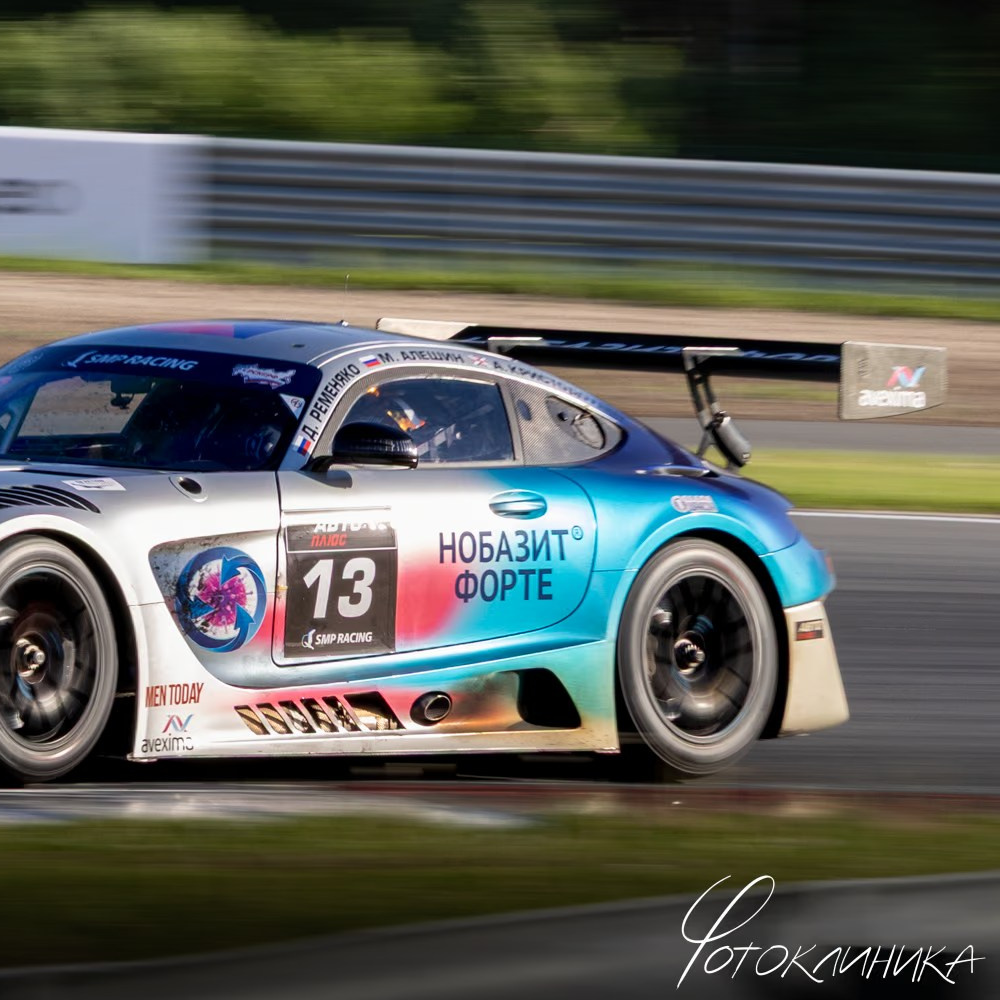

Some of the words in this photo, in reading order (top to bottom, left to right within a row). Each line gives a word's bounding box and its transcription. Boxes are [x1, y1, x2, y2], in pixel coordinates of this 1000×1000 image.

[86, 354, 129, 364] SMP
[124, 355, 199, 371] RACING
[377, 352, 400, 364] М.
[401, 350, 466, 364] АЛЕШИН
[309, 363, 361, 424] РЕМЕНЯКО
[302, 421, 319, 442] Д.
[311, 533, 348, 547] ПЛЮС
[303, 557, 377, 619] 13
[455, 568, 553, 603] ФОРТЕ
[315, 633, 337, 645] SMP
[337, 632, 373, 645] RACING
[145, 685, 167, 708] MEN
[168, 682, 205, 706] TODAY
